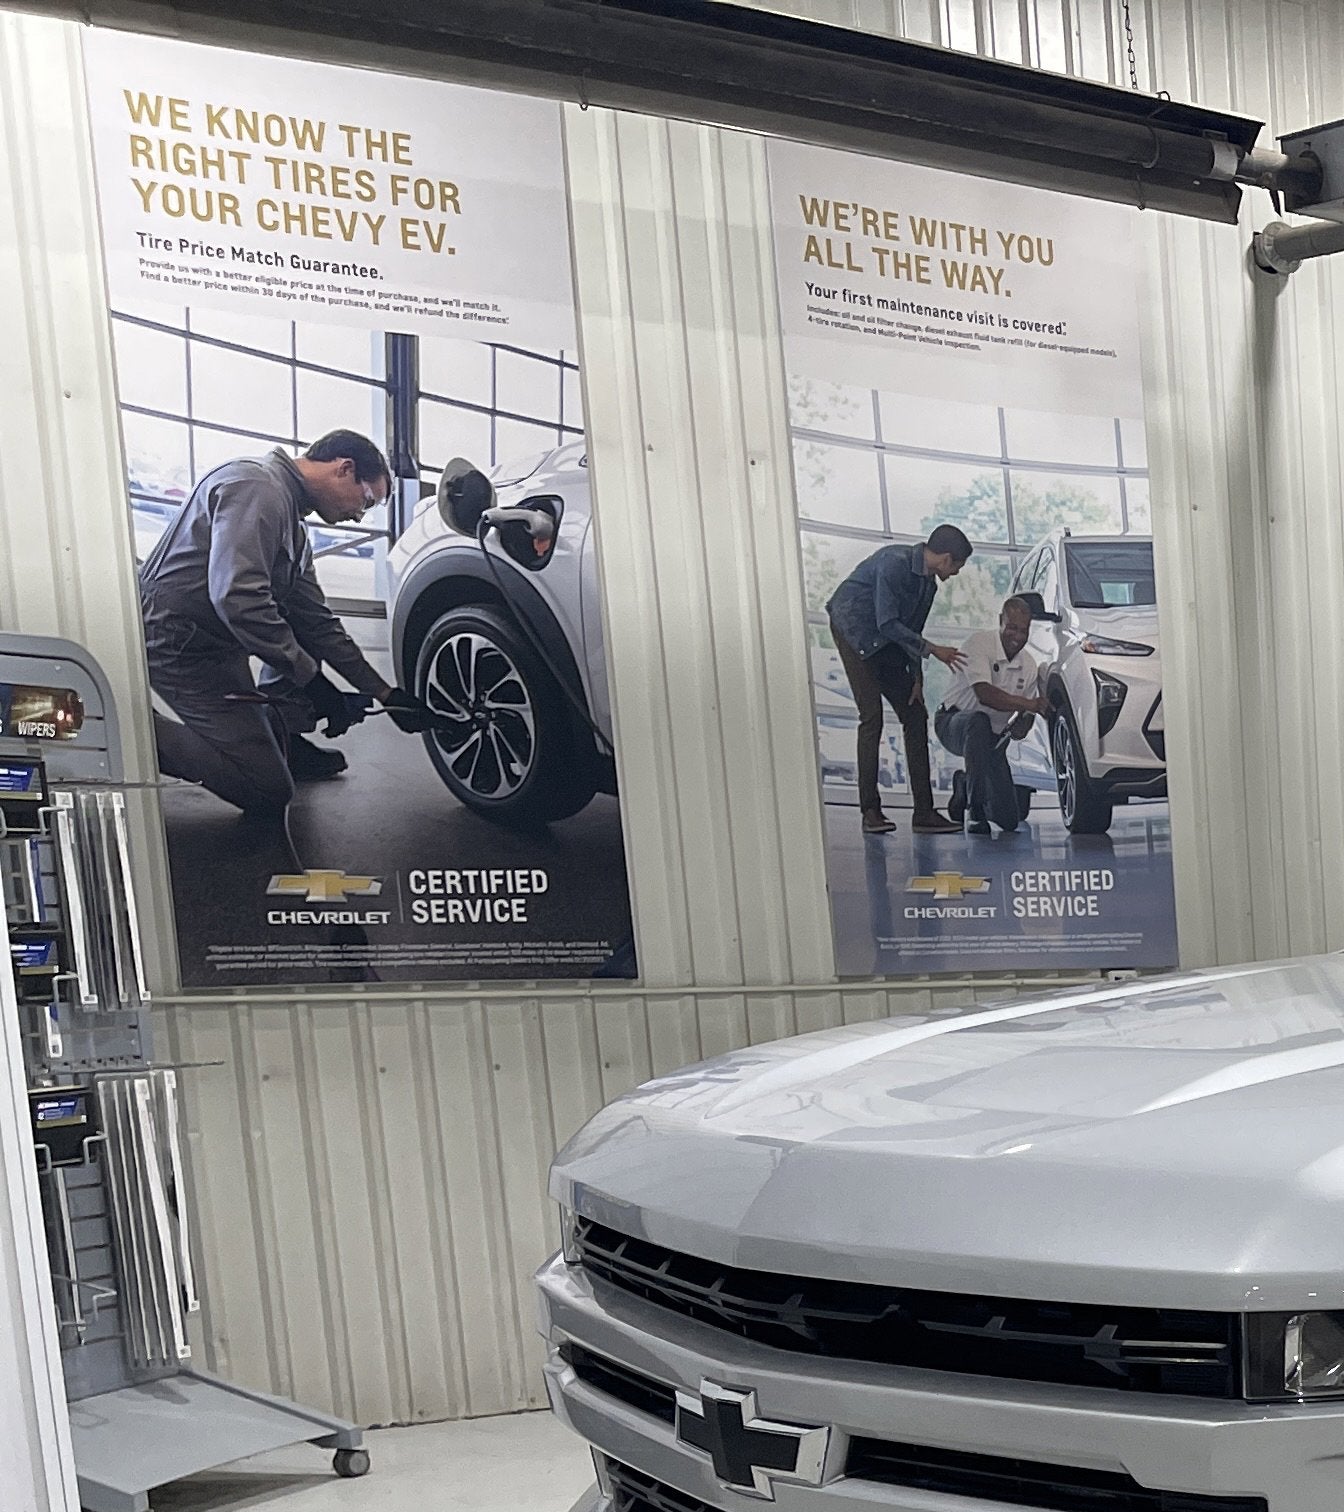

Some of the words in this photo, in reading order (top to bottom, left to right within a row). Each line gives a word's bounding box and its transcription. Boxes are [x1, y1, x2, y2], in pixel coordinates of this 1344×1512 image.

[123, 89, 192, 132] WE
[205, 103, 326, 153] KNOW
[338, 124, 414, 166] THE
[130, 134, 252, 184] RIGHT
[264, 155, 376, 203] TIRES
[390, 174, 462, 215] FOR
[131, 177, 243, 228] YOUR
[256, 198, 387, 246] CHEVY
[400, 217, 456, 256] EV.
[799, 195, 900, 241] WE'RE
[909, 215, 988, 257] WITH
[996, 230, 1054, 267] YOU
[136, 231, 172, 252] Tire
[179, 238, 226, 260] Price
[231, 246, 284, 268] Match
[290, 255, 384, 280] Guarantee.
[803, 235, 863, 273] ALL
[872, 247, 932, 285] THE
[941, 259, 1012, 298] WAY.
[139, 258, 175, 271] Provide
[178, 266, 190, 274] us
[191, 267, 213, 276] with
[223, 270, 253, 282] better
[255, 275, 288, 288] eligible
[290, 281, 314, 291] price
[316, 284, 326, 292] at
[327, 284, 342, 293] the
[344, 287, 365, 296] time
[378, 291, 421, 304] purchase,
[423, 296, 439, 304] and
[441, 299, 461, 308] we'll
[463, 301, 490, 311] match
[140, 271, 161, 282] Find
[172, 275, 202, 287] better
[204, 281, 228, 291] price
[231, 284, 260, 295] within
[276, 290, 297, 302] days
[299, 292, 309, 301] of
[311, 295, 326, 304] the
[328, 298, 372, 310] purchase,
[374, 302, 390, 311] and
[392, 305, 412, 313] we'll
[414, 307, 443, 317] refund
[446, 310, 460, 319] the
[805, 281, 838, 300] Your
[842, 288, 873, 307] first
[877, 297, 963, 322] maintenance
[966, 310, 995, 326] visit
[998, 313, 1009, 328] is
[18, 721, 56, 738] WIPERS
[408, 869, 549, 895] CERTIFIED
[1010, 869, 1115, 893] CERTIFIED
[266, 910, 392, 926] CHEVROLET
[411, 898, 528, 924] SERVICE
[903, 906, 997, 919] CHEVROLET
[1012, 895, 1100, 918] SERVICE
